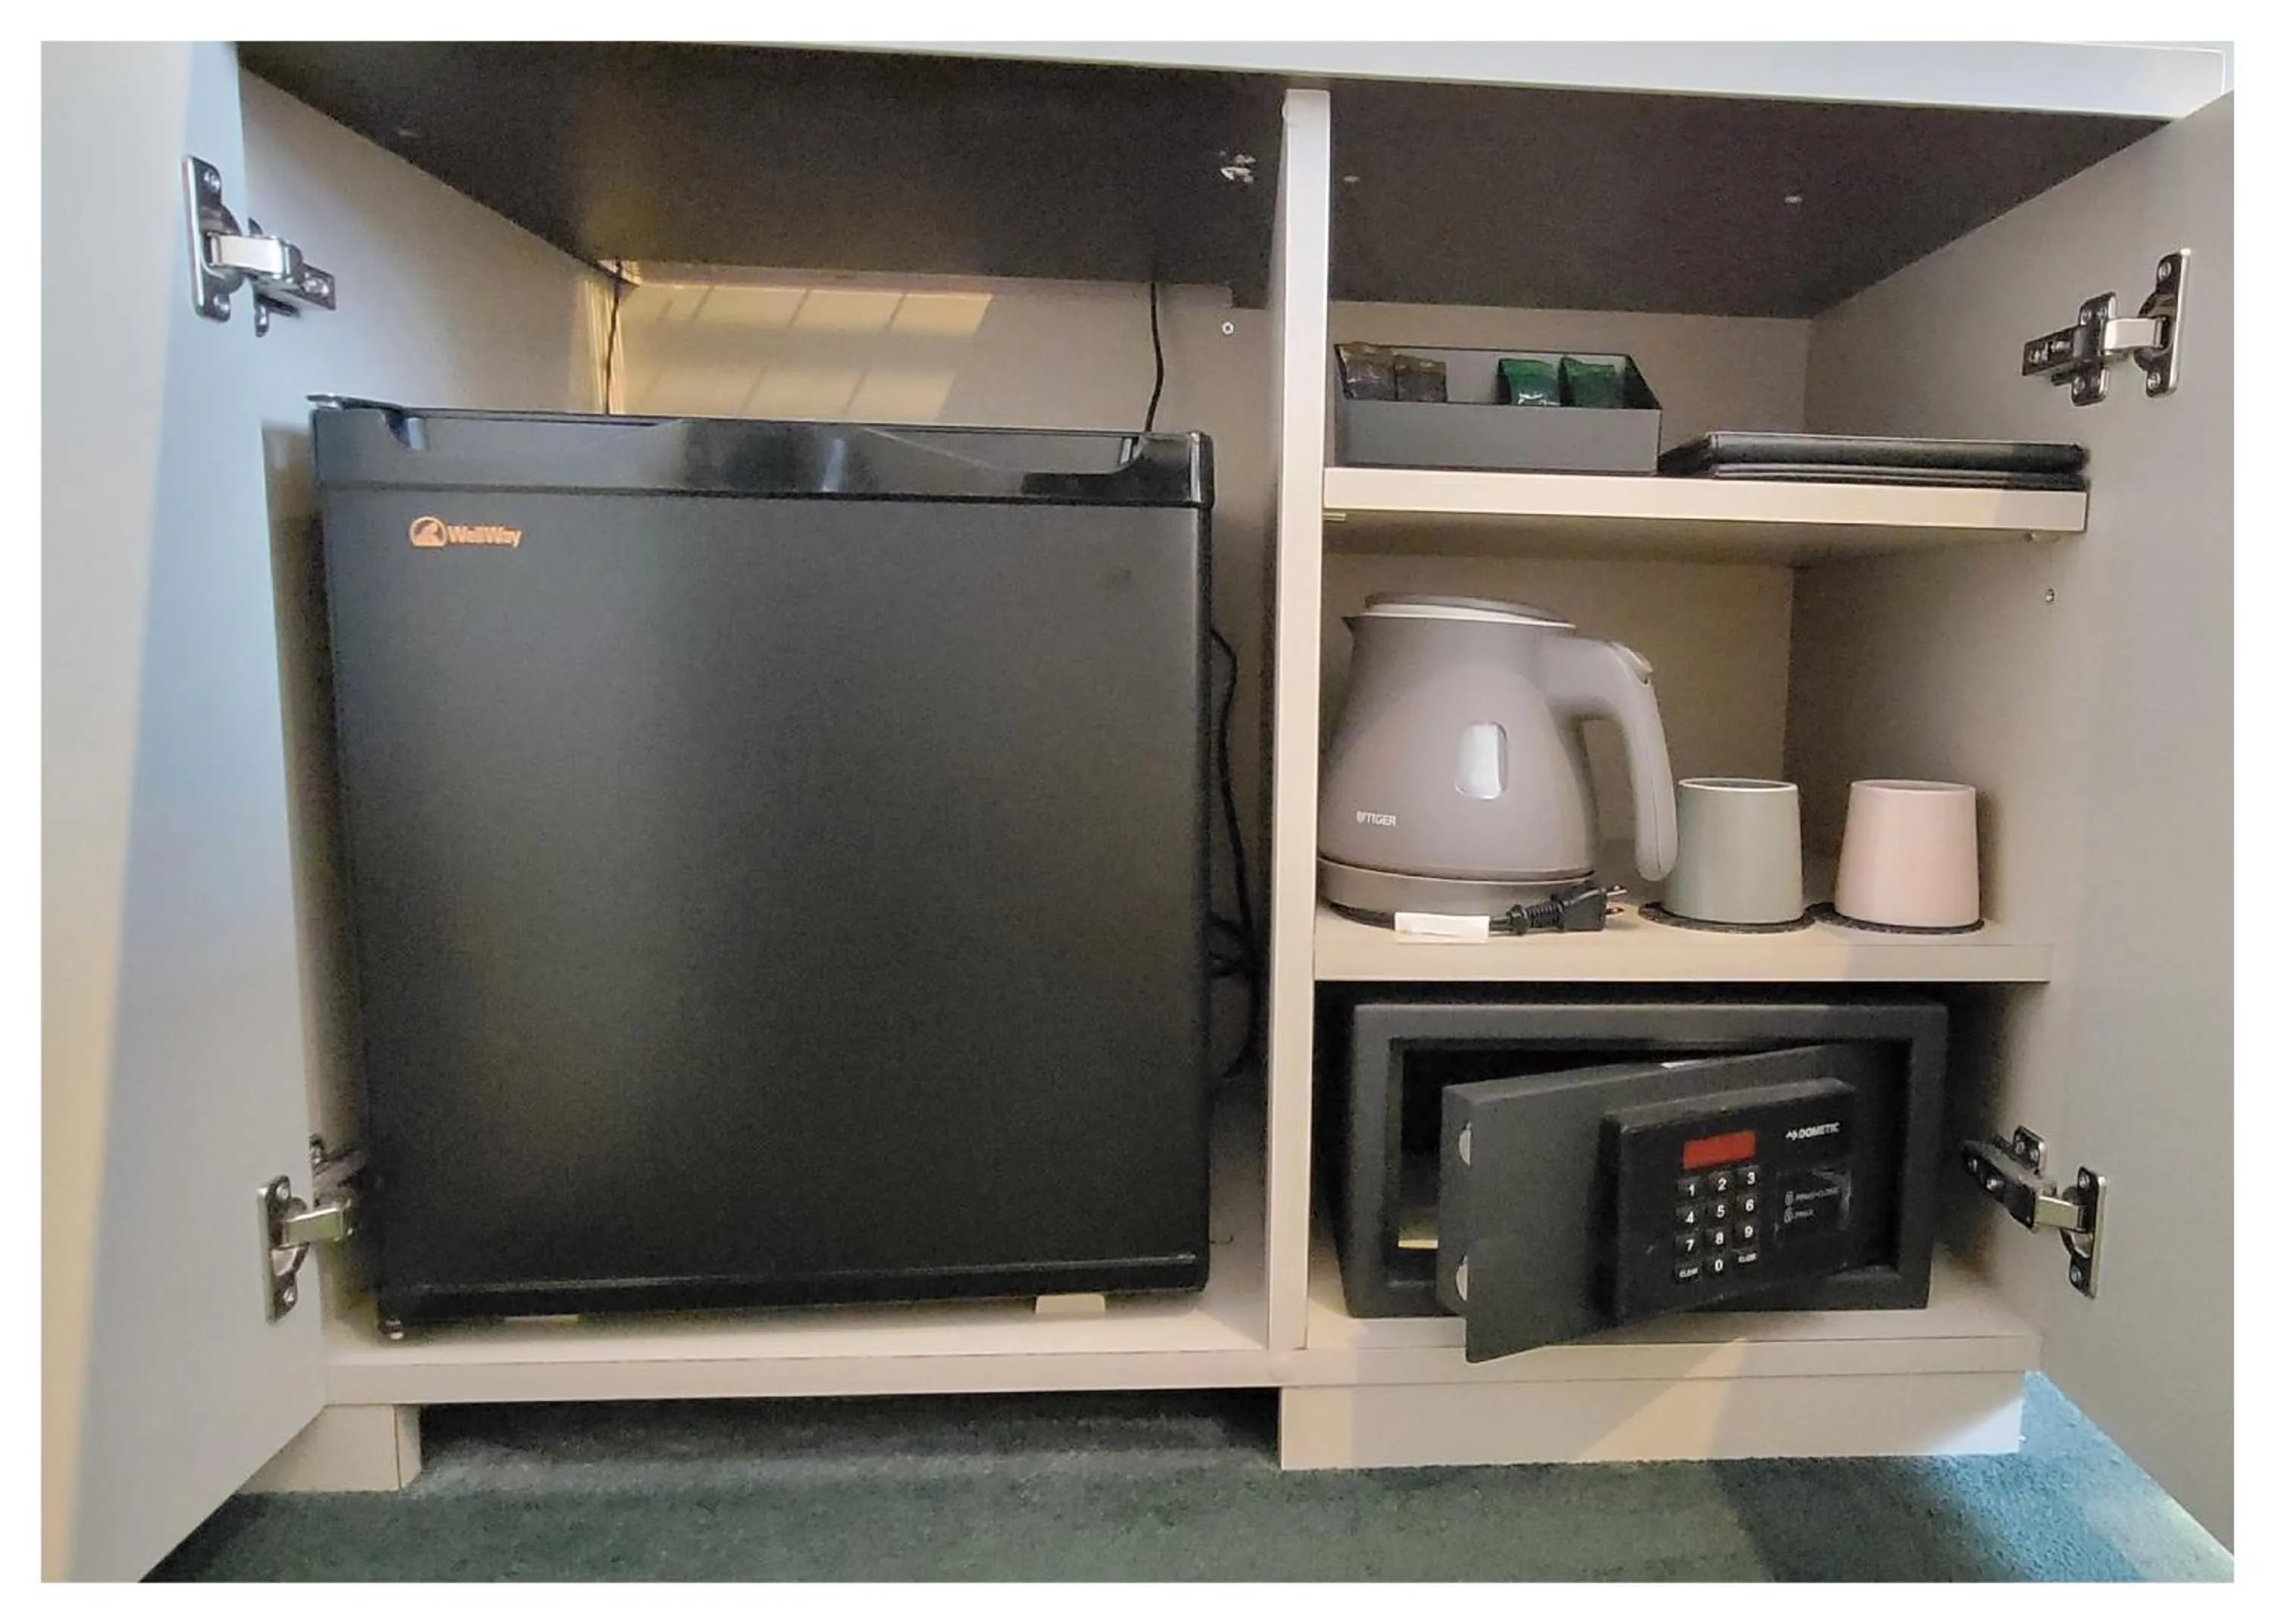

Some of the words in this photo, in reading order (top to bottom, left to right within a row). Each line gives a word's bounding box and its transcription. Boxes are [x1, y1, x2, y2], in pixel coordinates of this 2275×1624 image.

[1366, 812, 1396, 826] TIGER
[1798, 1122, 1840, 1139] DOMETIC
[1688, 1184, 1695, 1196] 1
[1718, 1177, 1727, 1191] 2
[1746, 1171, 1756, 1184] 3
[1685, 1211, 1694, 1223] 4
[1717, 1205, 1725, 1218] 5
[1746, 1199, 1754, 1212] 6
[1686, 1239, 1695, 1251] 7
[1715, 1231, 1724, 1245] 8
[1745, 1225, 1753, 1238] 9
[1715, 1259, 1724, 1271] 0
